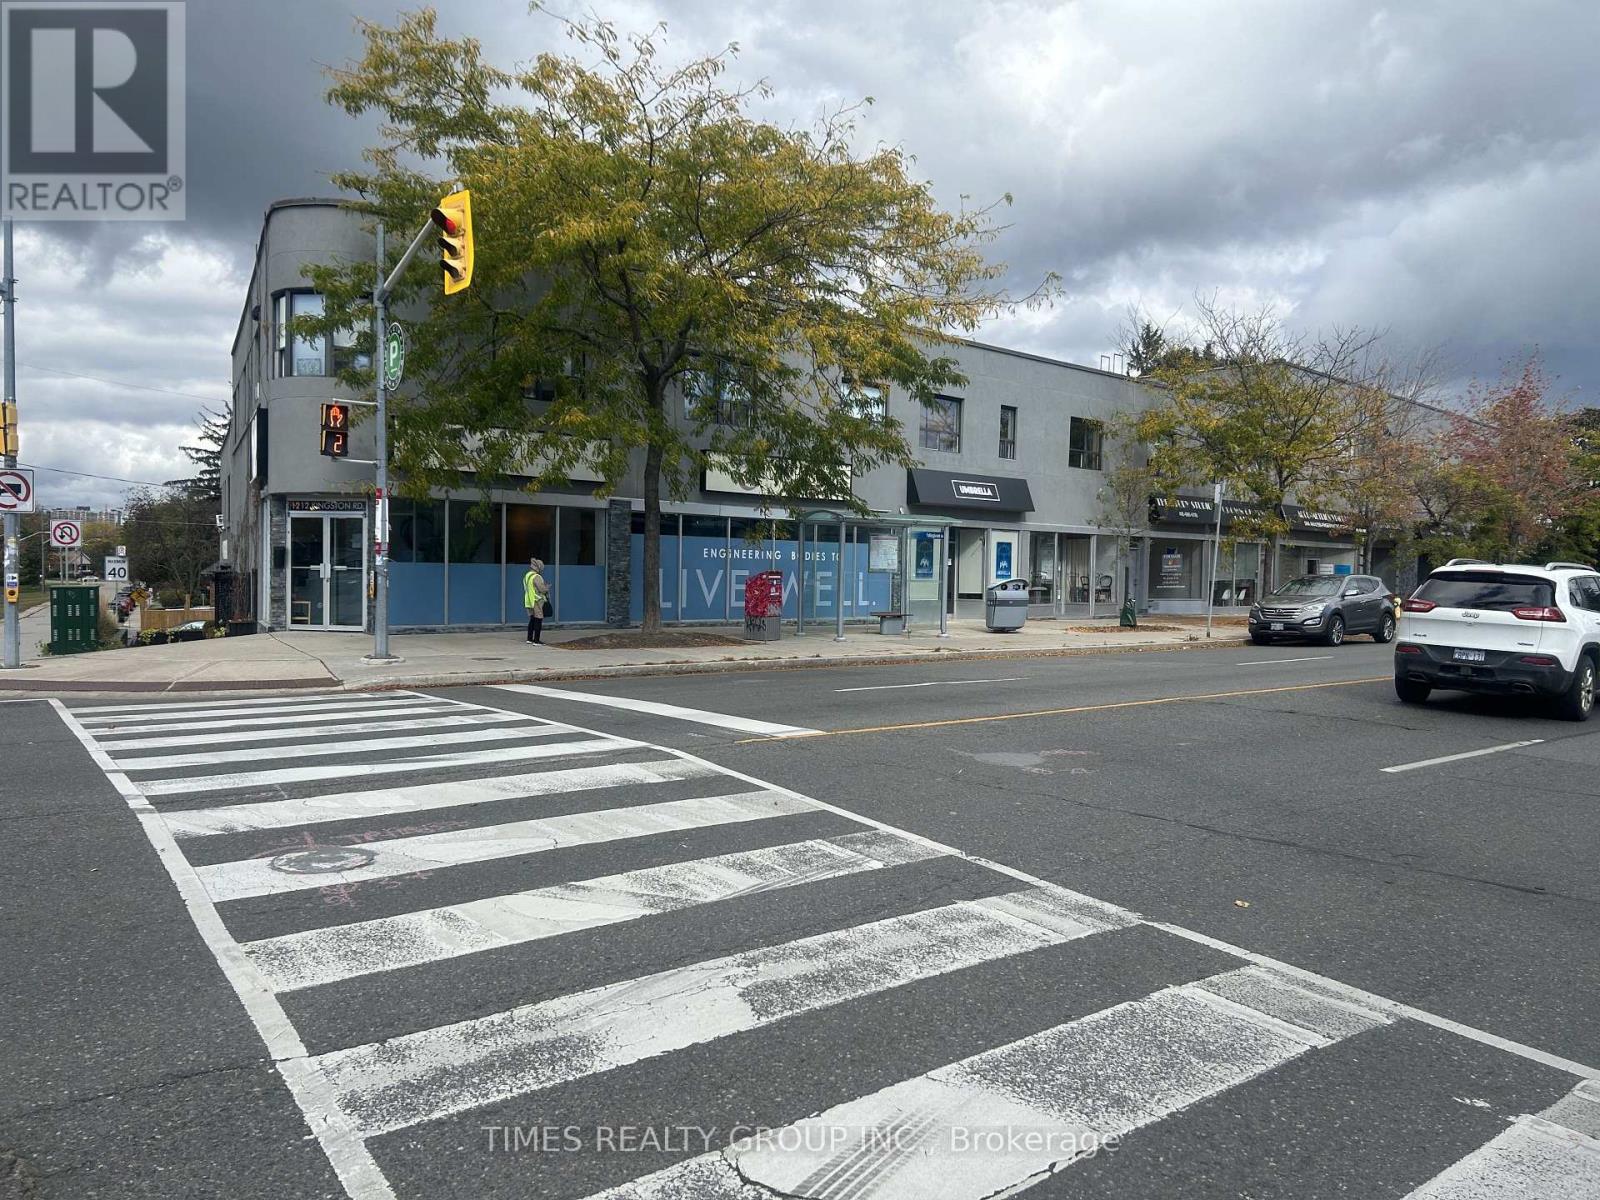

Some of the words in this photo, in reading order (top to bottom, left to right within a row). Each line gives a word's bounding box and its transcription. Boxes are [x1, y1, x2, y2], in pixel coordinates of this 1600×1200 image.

[389, 341, 399, 367] P
[333, 434, 343, 453] 2
[959, 485, 993, 496] UMBRELLA
[310, 501, 350, 510] KINGSTON
[703, 548, 782, 560] ENGINEERING
[791, 551, 826, 561] BDIES
[108, 567, 127, 578] 40
[659, 568, 749, 608] LIVE
[1461, 611, 1480, 619] Jeep
